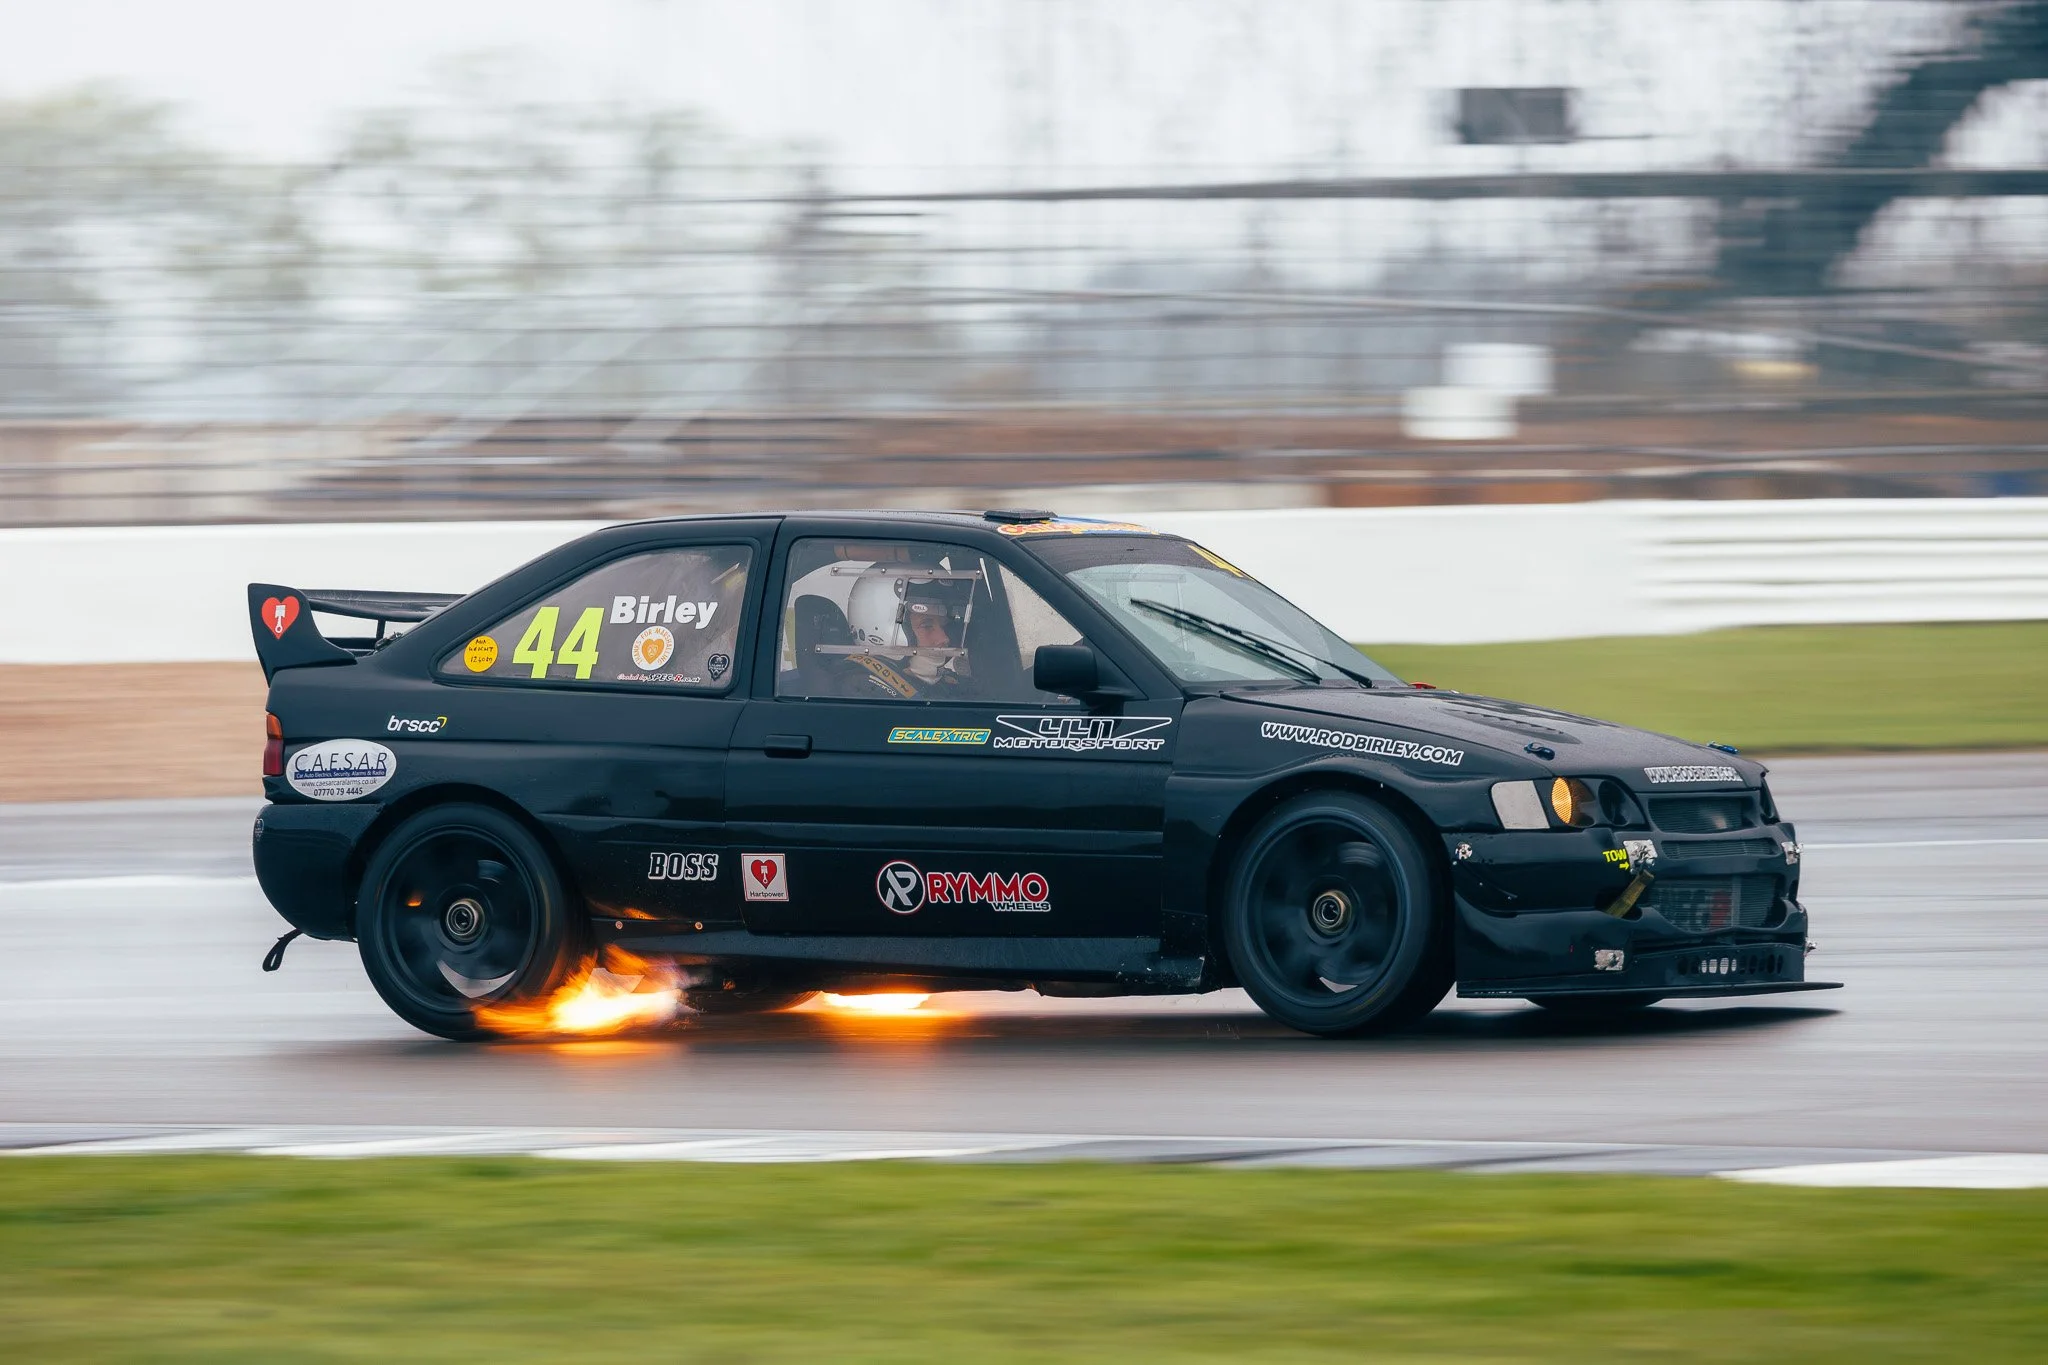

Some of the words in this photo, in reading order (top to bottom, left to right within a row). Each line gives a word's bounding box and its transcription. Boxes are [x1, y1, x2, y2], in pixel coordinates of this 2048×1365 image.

[610, 595, 718, 629] Birley
[641, 629, 653, 640] FOR
[512, 606, 605, 680] 44
[387, 715, 441, 733] brscc
[894, 729, 985, 742] SCALEXTRIC
[993, 737, 1166, 750] MOTORSPORT
[1261, 721, 1465, 766] WWW.RODBIRLEY.COM
[372, 769, 385, 777] Radio
[301, 778, 377, 787] www.caesarcaralarms.co.uk
[313, 788, 335, 796] 07770
[336, 788, 345, 796] 79
[346, 787, 363, 795] 4445
[1602, 848, 1627, 863] TOW
[648, 852, 719, 881] BOSS
[749, 890, 785, 898] Hartpower
[927, 872, 1049, 904] RYMMO
[991, 902, 1052, 912] WHEELS
